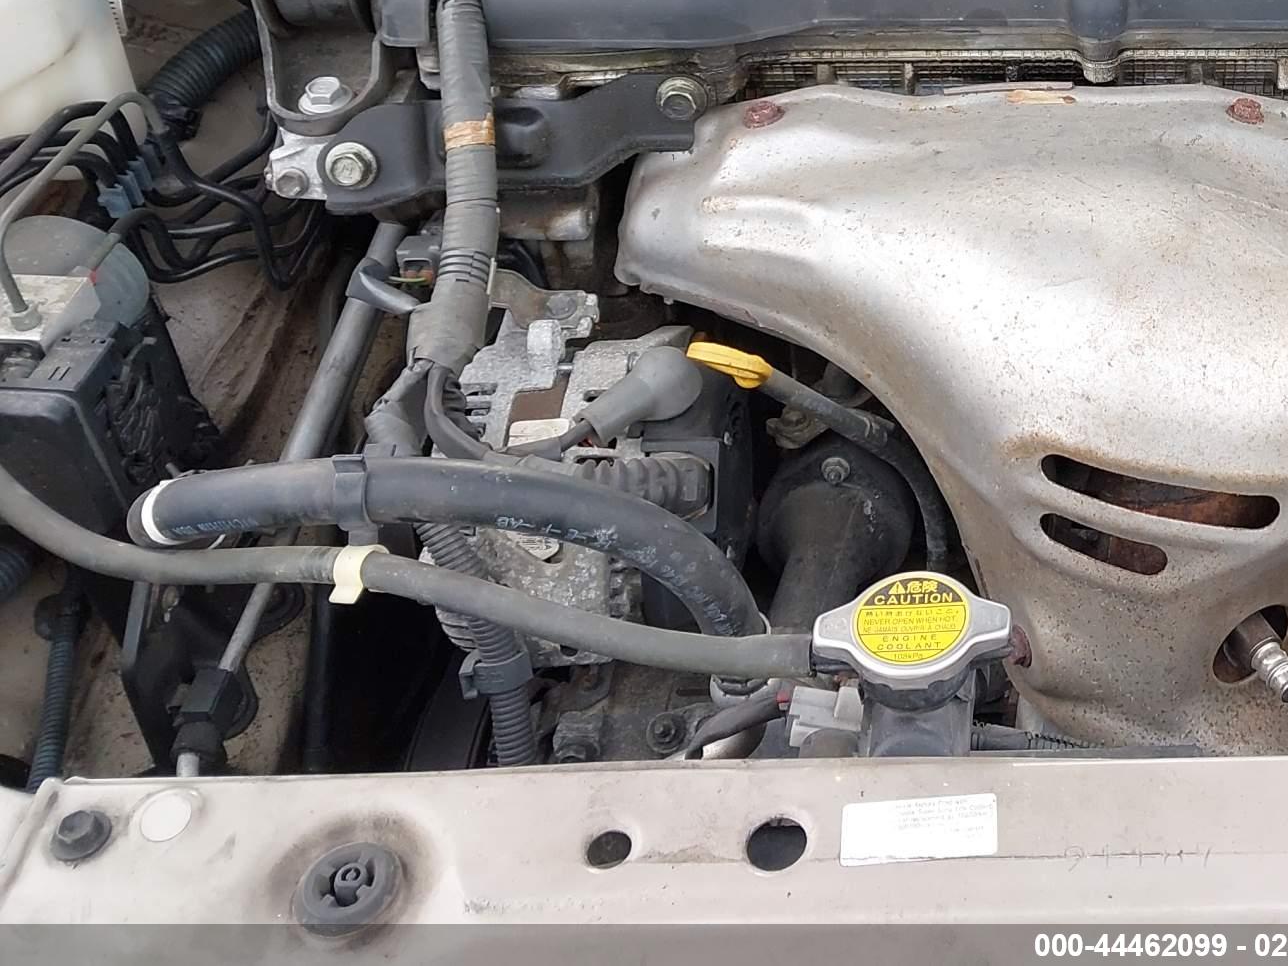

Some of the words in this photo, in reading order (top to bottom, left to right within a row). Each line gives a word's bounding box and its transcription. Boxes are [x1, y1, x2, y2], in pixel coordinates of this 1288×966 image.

[907, 580, 938, 593] 危険
[874, 593, 953, 605] CAUTION
[863, 618, 890, 626] NEVER
[892, 617, 914, 625] OPEN
[916, 616, 938, 624] WHEN
[882, 634, 938, 643] ENGINE
[877, 642, 942, 650] COOLANT
